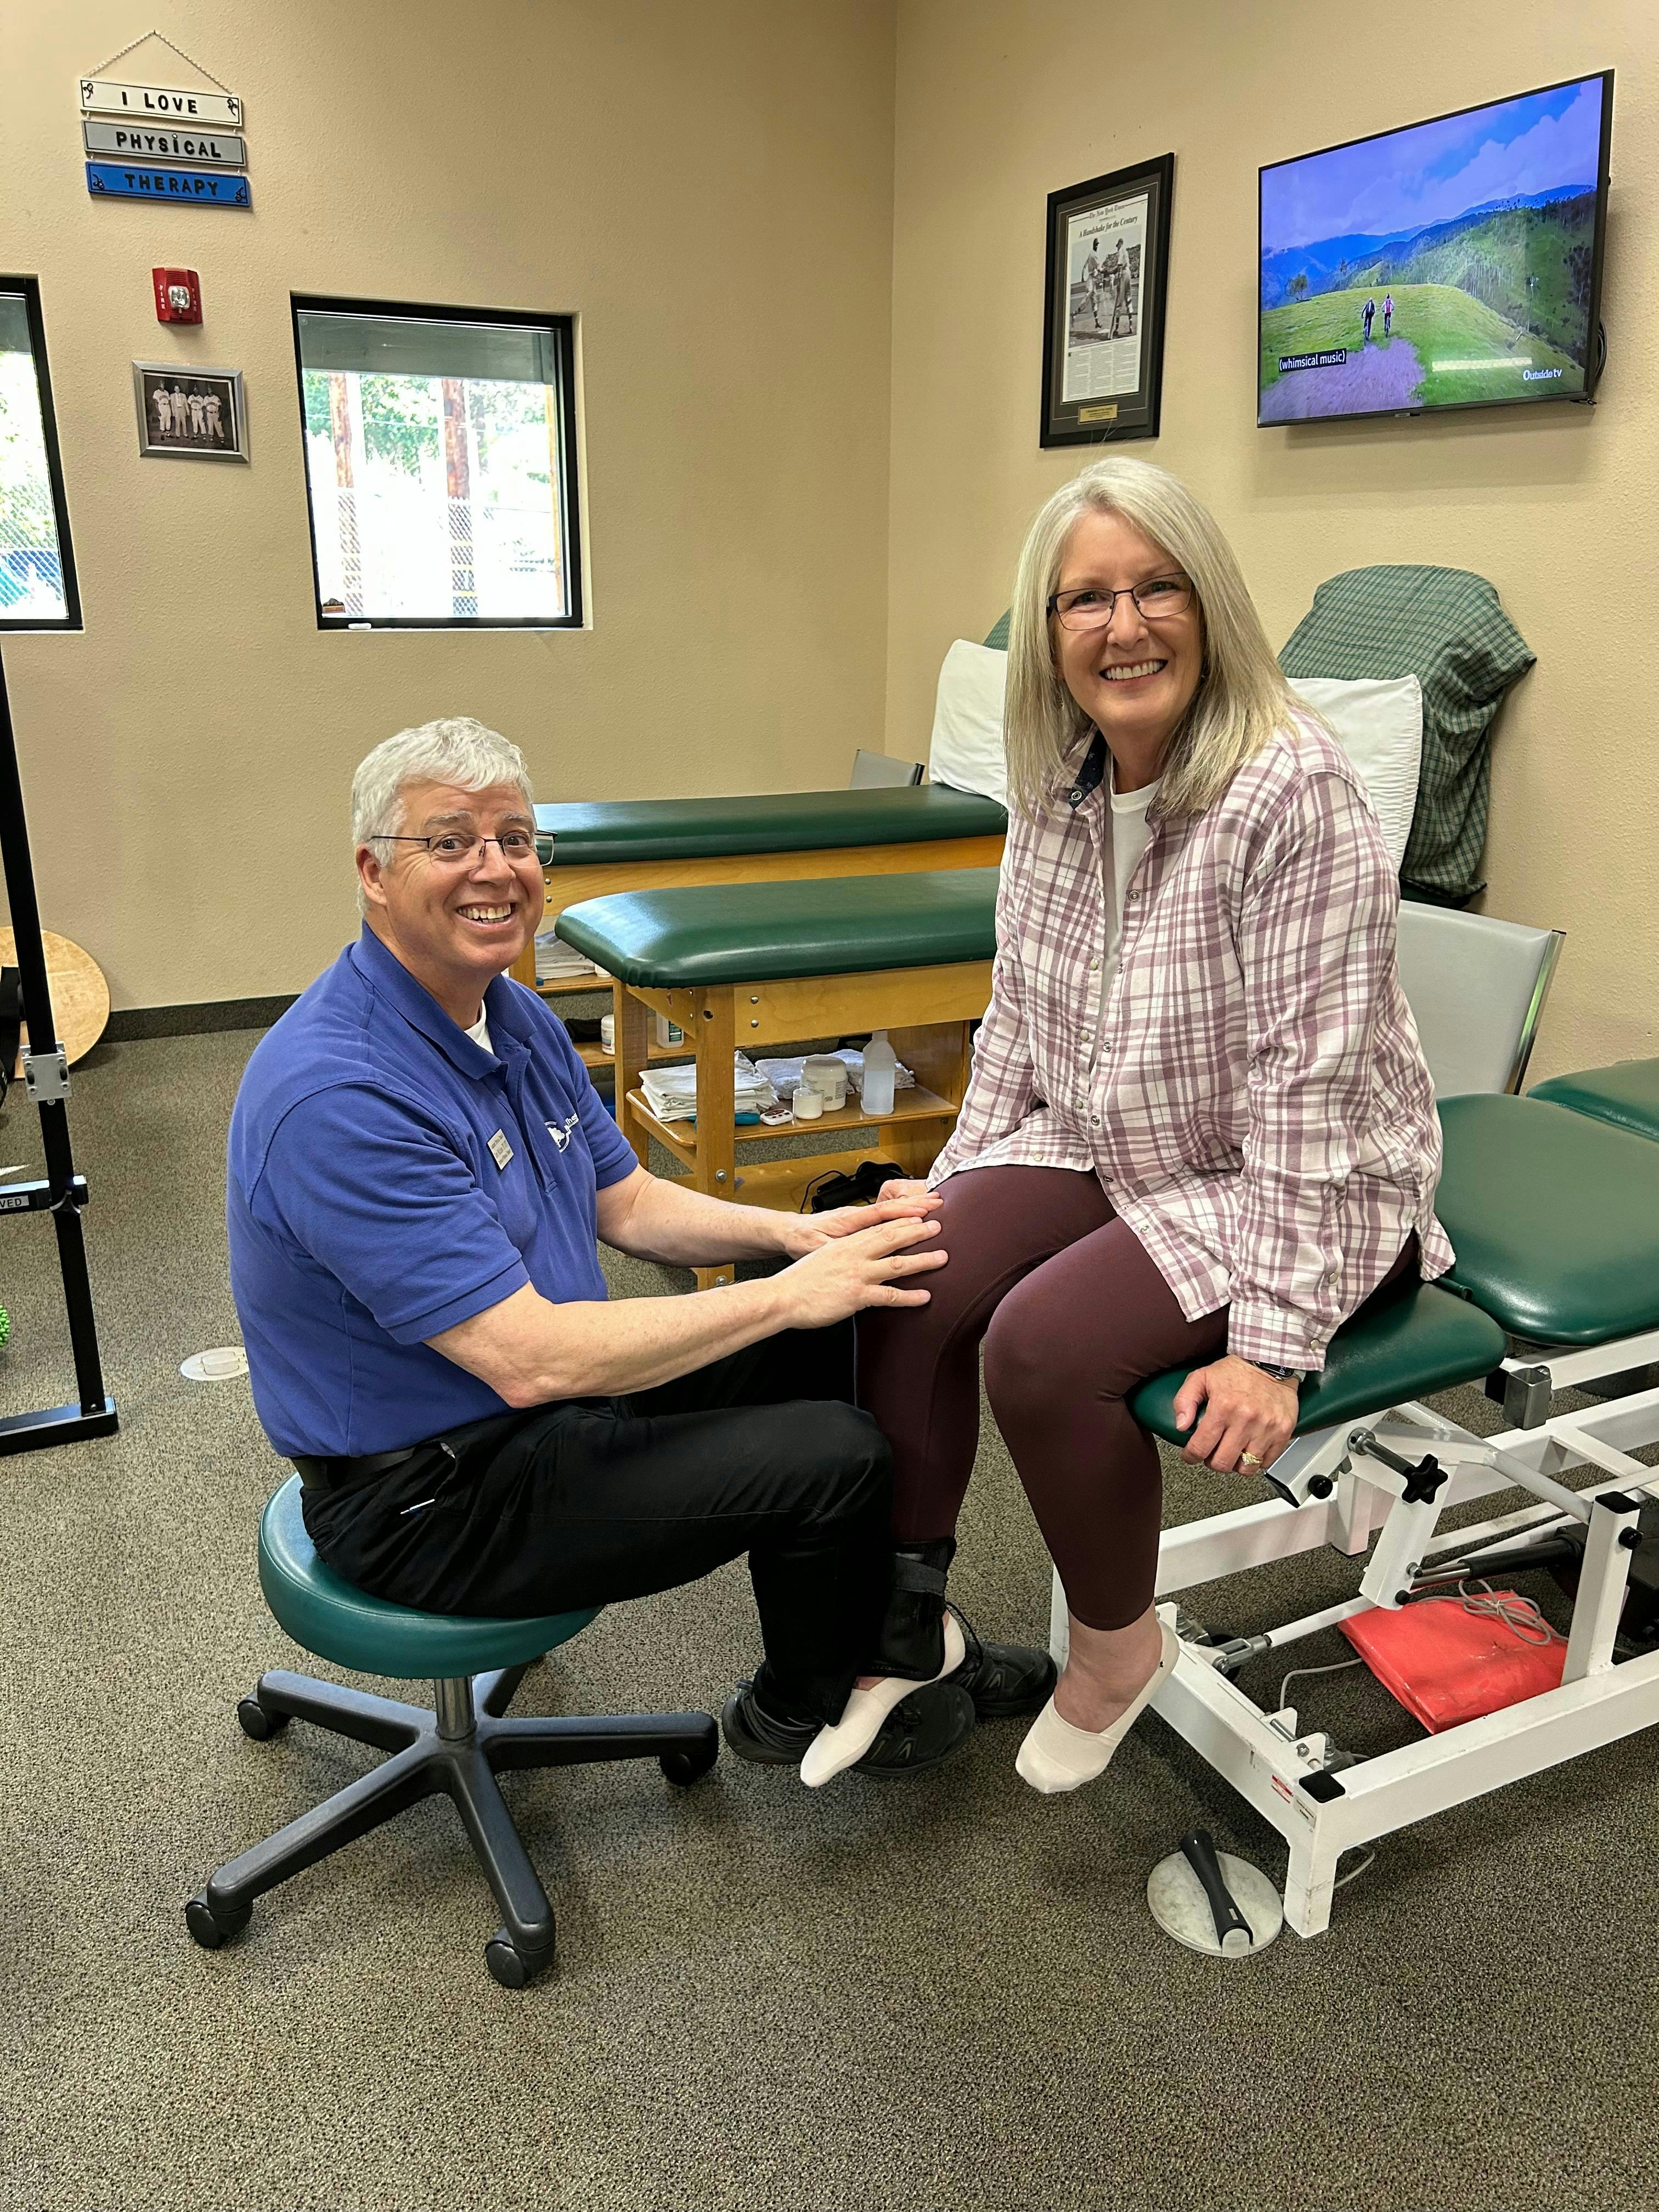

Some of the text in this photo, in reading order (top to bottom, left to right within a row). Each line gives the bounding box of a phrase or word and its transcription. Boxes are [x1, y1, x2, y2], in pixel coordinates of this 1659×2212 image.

[121, 91, 198, 114] I LOVE
[116, 131, 221, 158] PHYSICAL
[124, 173, 218, 195] THERAPY
[1120, 216, 1138, 226] Century
[1279, 350, 1345, 371] (whimsical music)
